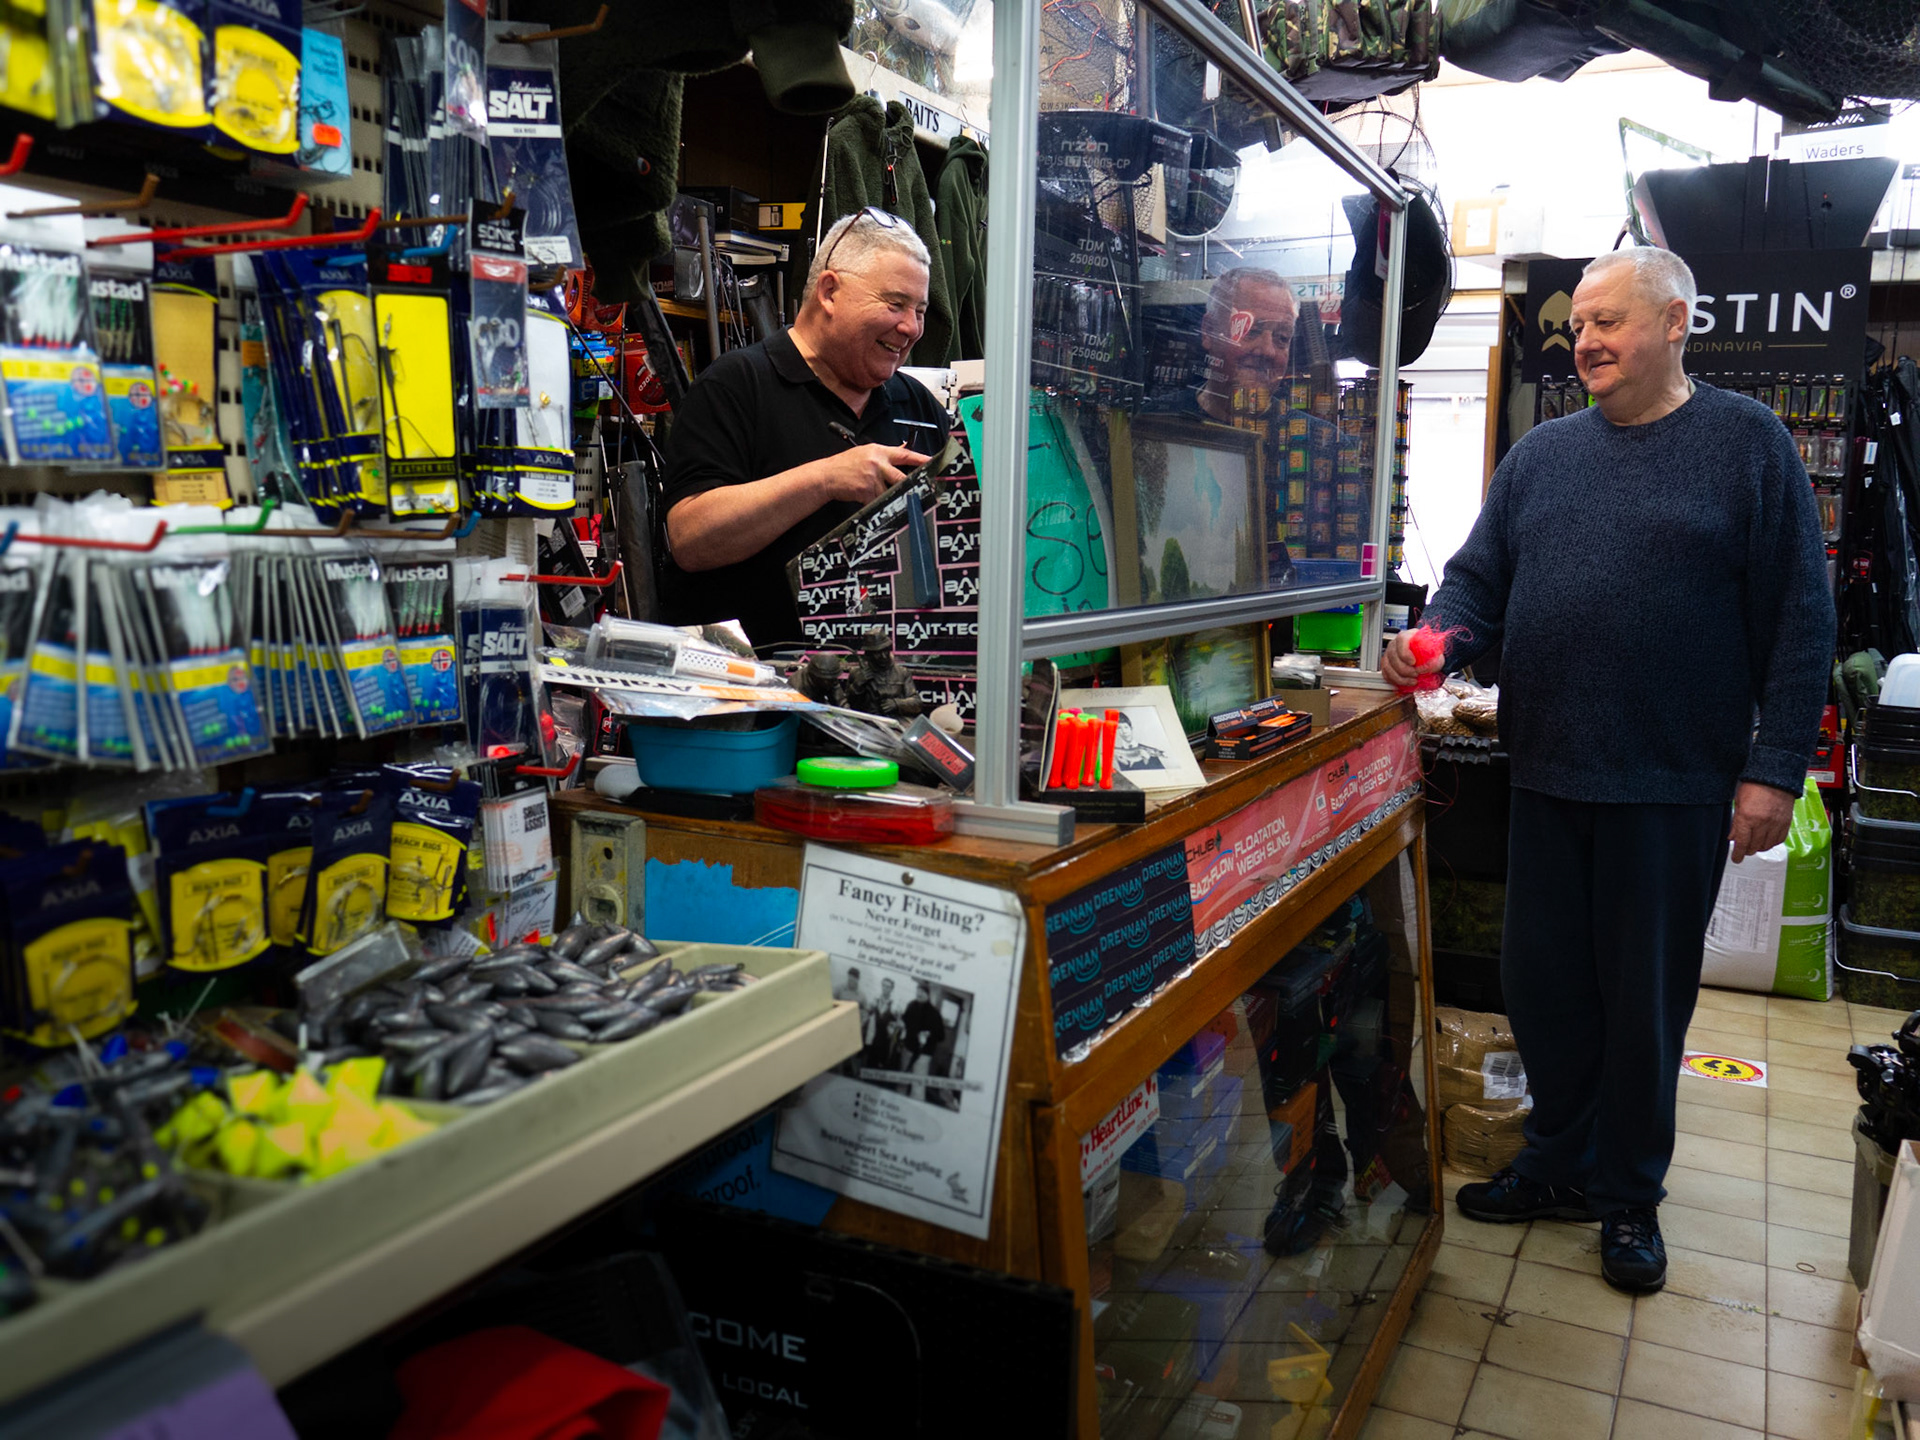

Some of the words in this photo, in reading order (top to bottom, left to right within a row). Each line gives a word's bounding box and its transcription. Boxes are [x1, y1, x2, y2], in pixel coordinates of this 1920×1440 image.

[488, 90, 553, 119] SALT
[905, 98, 940, 133] BAITS
[1806, 143, 1864, 159] Waders
[1078, 239, 1104, 252] TDM
[1069, 253, 1109, 268] 2508QD
[89, 280, 144, 301] ustad
[1689, 291, 1833, 335] STIN
[1684, 341, 1763, 353] NDINAVIA
[534, 454, 564, 466] AXIA
[483, 631, 528, 656] SALT
[896, 621, 978, 643] BAIT-TEC
[398, 792, 451, 811] AXIA
[188, 824, 241, 845] AXIA
[333, 821, 373, 842] AXIA
[393, 836, 421, 849] BEACH
[422, 839, 443, 851] RIGS
[1234, 816, 1286, 858] FLOATATION
[1186, 838, 1215, 864] CHUB
[1236, 848, 1266, 876] WEIGH
[1266, 831, 1291, 858] SLING
[1142, 851, 1186, 882] DRENNAN
[41, 880, 102, 908] AXIA
[837, 878, 897, 912] Fancy
[901, 894, 986, 934] Fishing?
[1094, 876, 1143, 911] DRENNAN
[865, 908, 900, 928] Never
[902, 916, 942, 938] Forget
[1046, 900, 1094, 934] RENNAN
[1147, 893, 1190, 926] DRENNAN
[858, 938, 895, 958] Donegal
[1099, 916, 1149, 952] DRENNAN
[1152, 931, 1194, 970] DRENNAN
[1104, 960, 1153, 998] DRENNAN
[1090, 1090, 1144, 1152] HeartLine
[902, 1153, 943, 1179] Angling
[687, 1311, 808, 1364] COME
[722, 1371, 809, 1410] LOCAL
